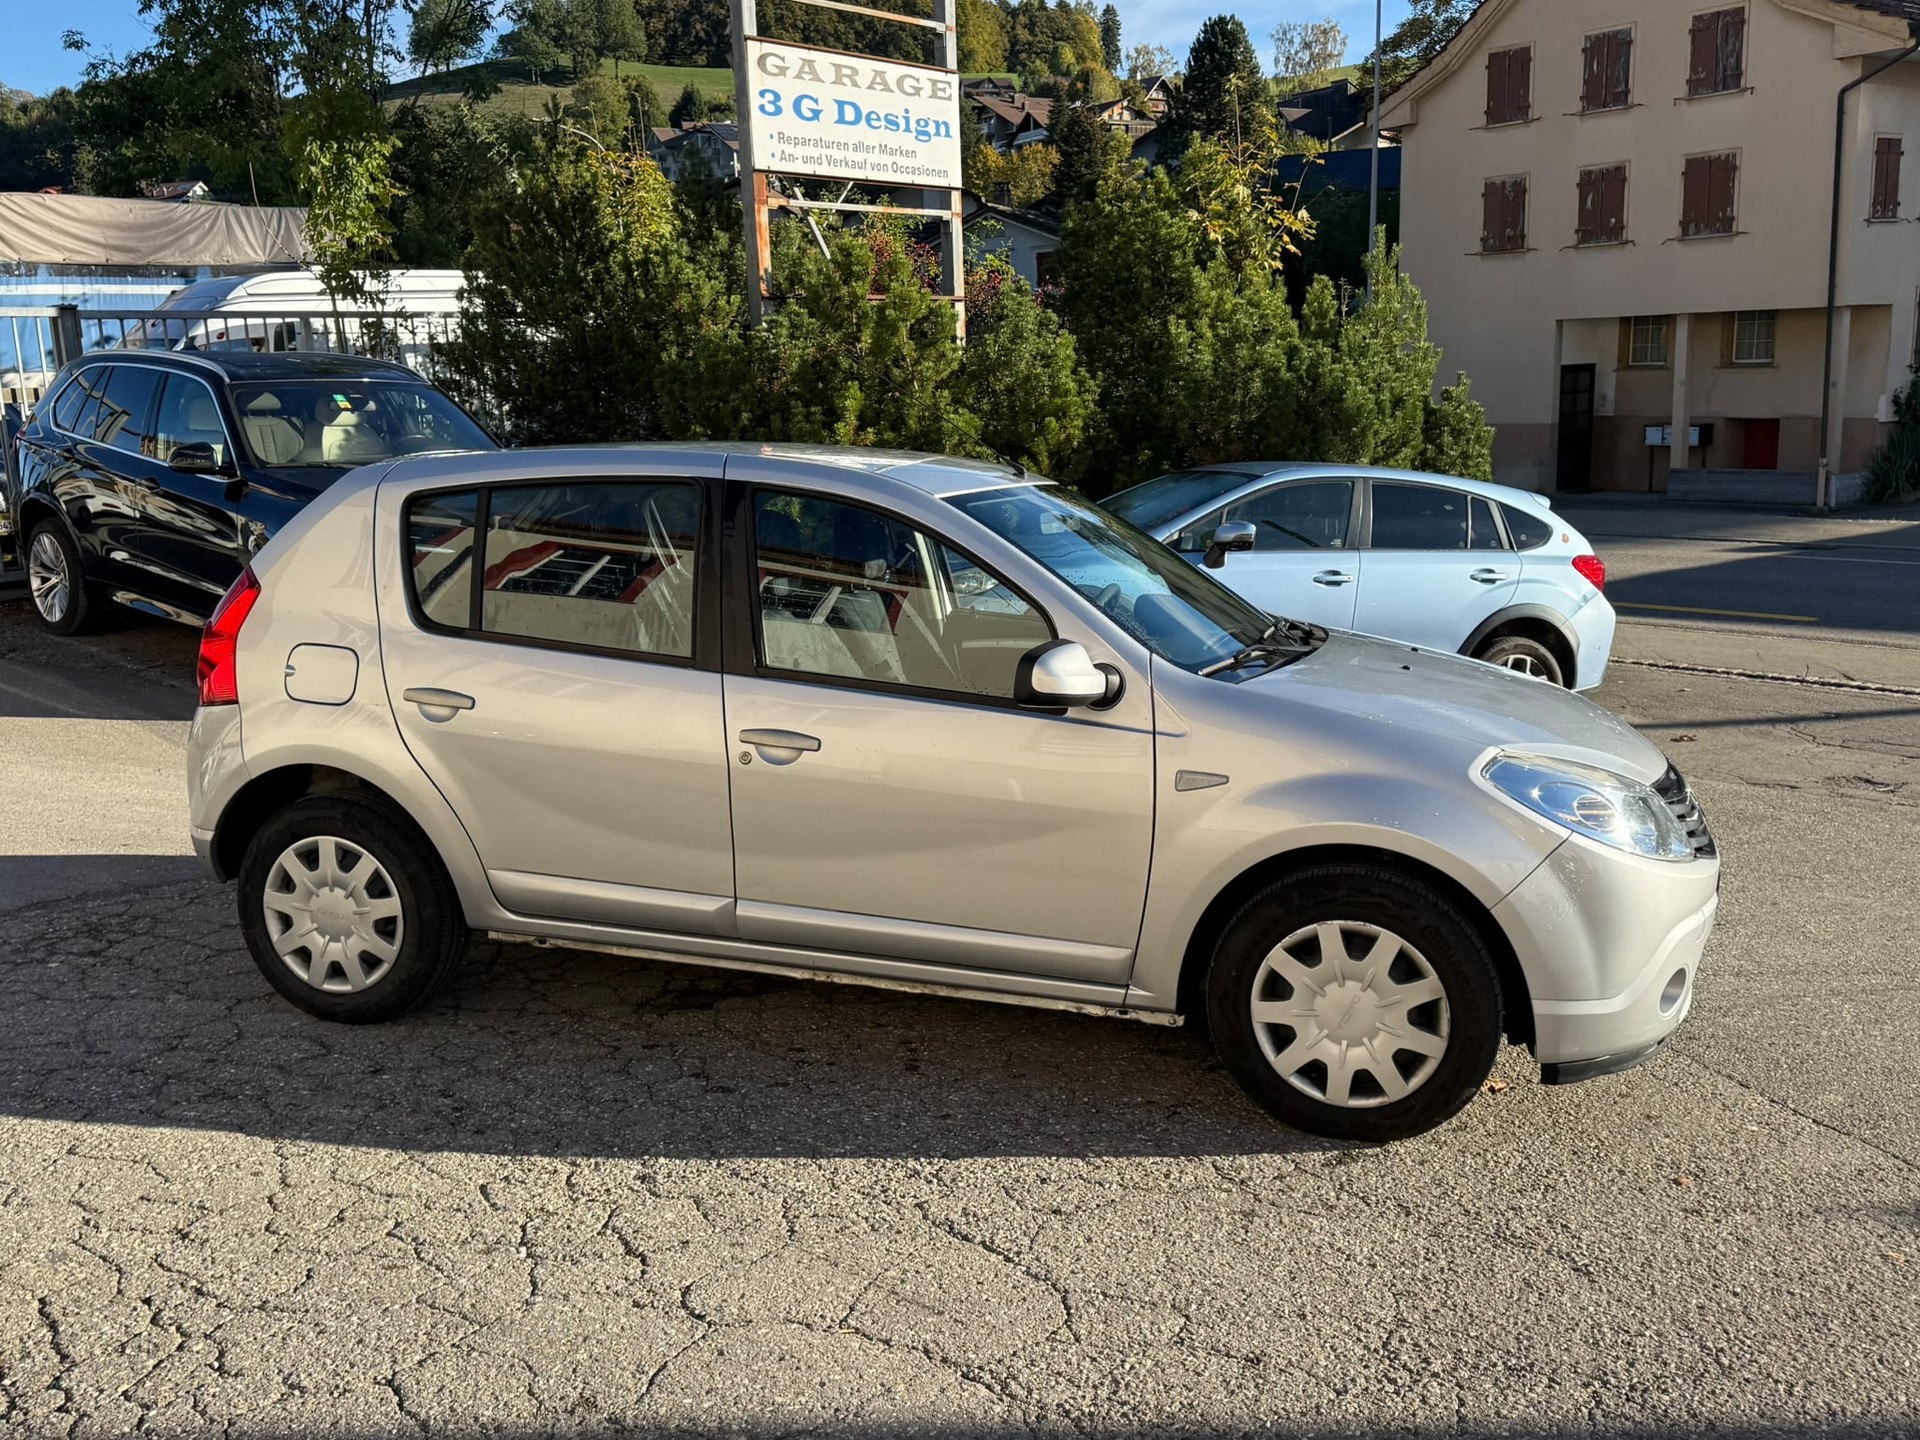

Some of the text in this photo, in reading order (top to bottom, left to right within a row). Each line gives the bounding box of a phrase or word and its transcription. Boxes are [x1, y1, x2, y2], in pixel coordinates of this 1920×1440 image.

[757, 51, 953, 102] GARAGE
[758, 88, 953, 143] 3 G Design
[777, 131, 917, 159] Reparaturen aller Marken
[779, 150, 949, 179] An- und Verkauf von Occasionen
